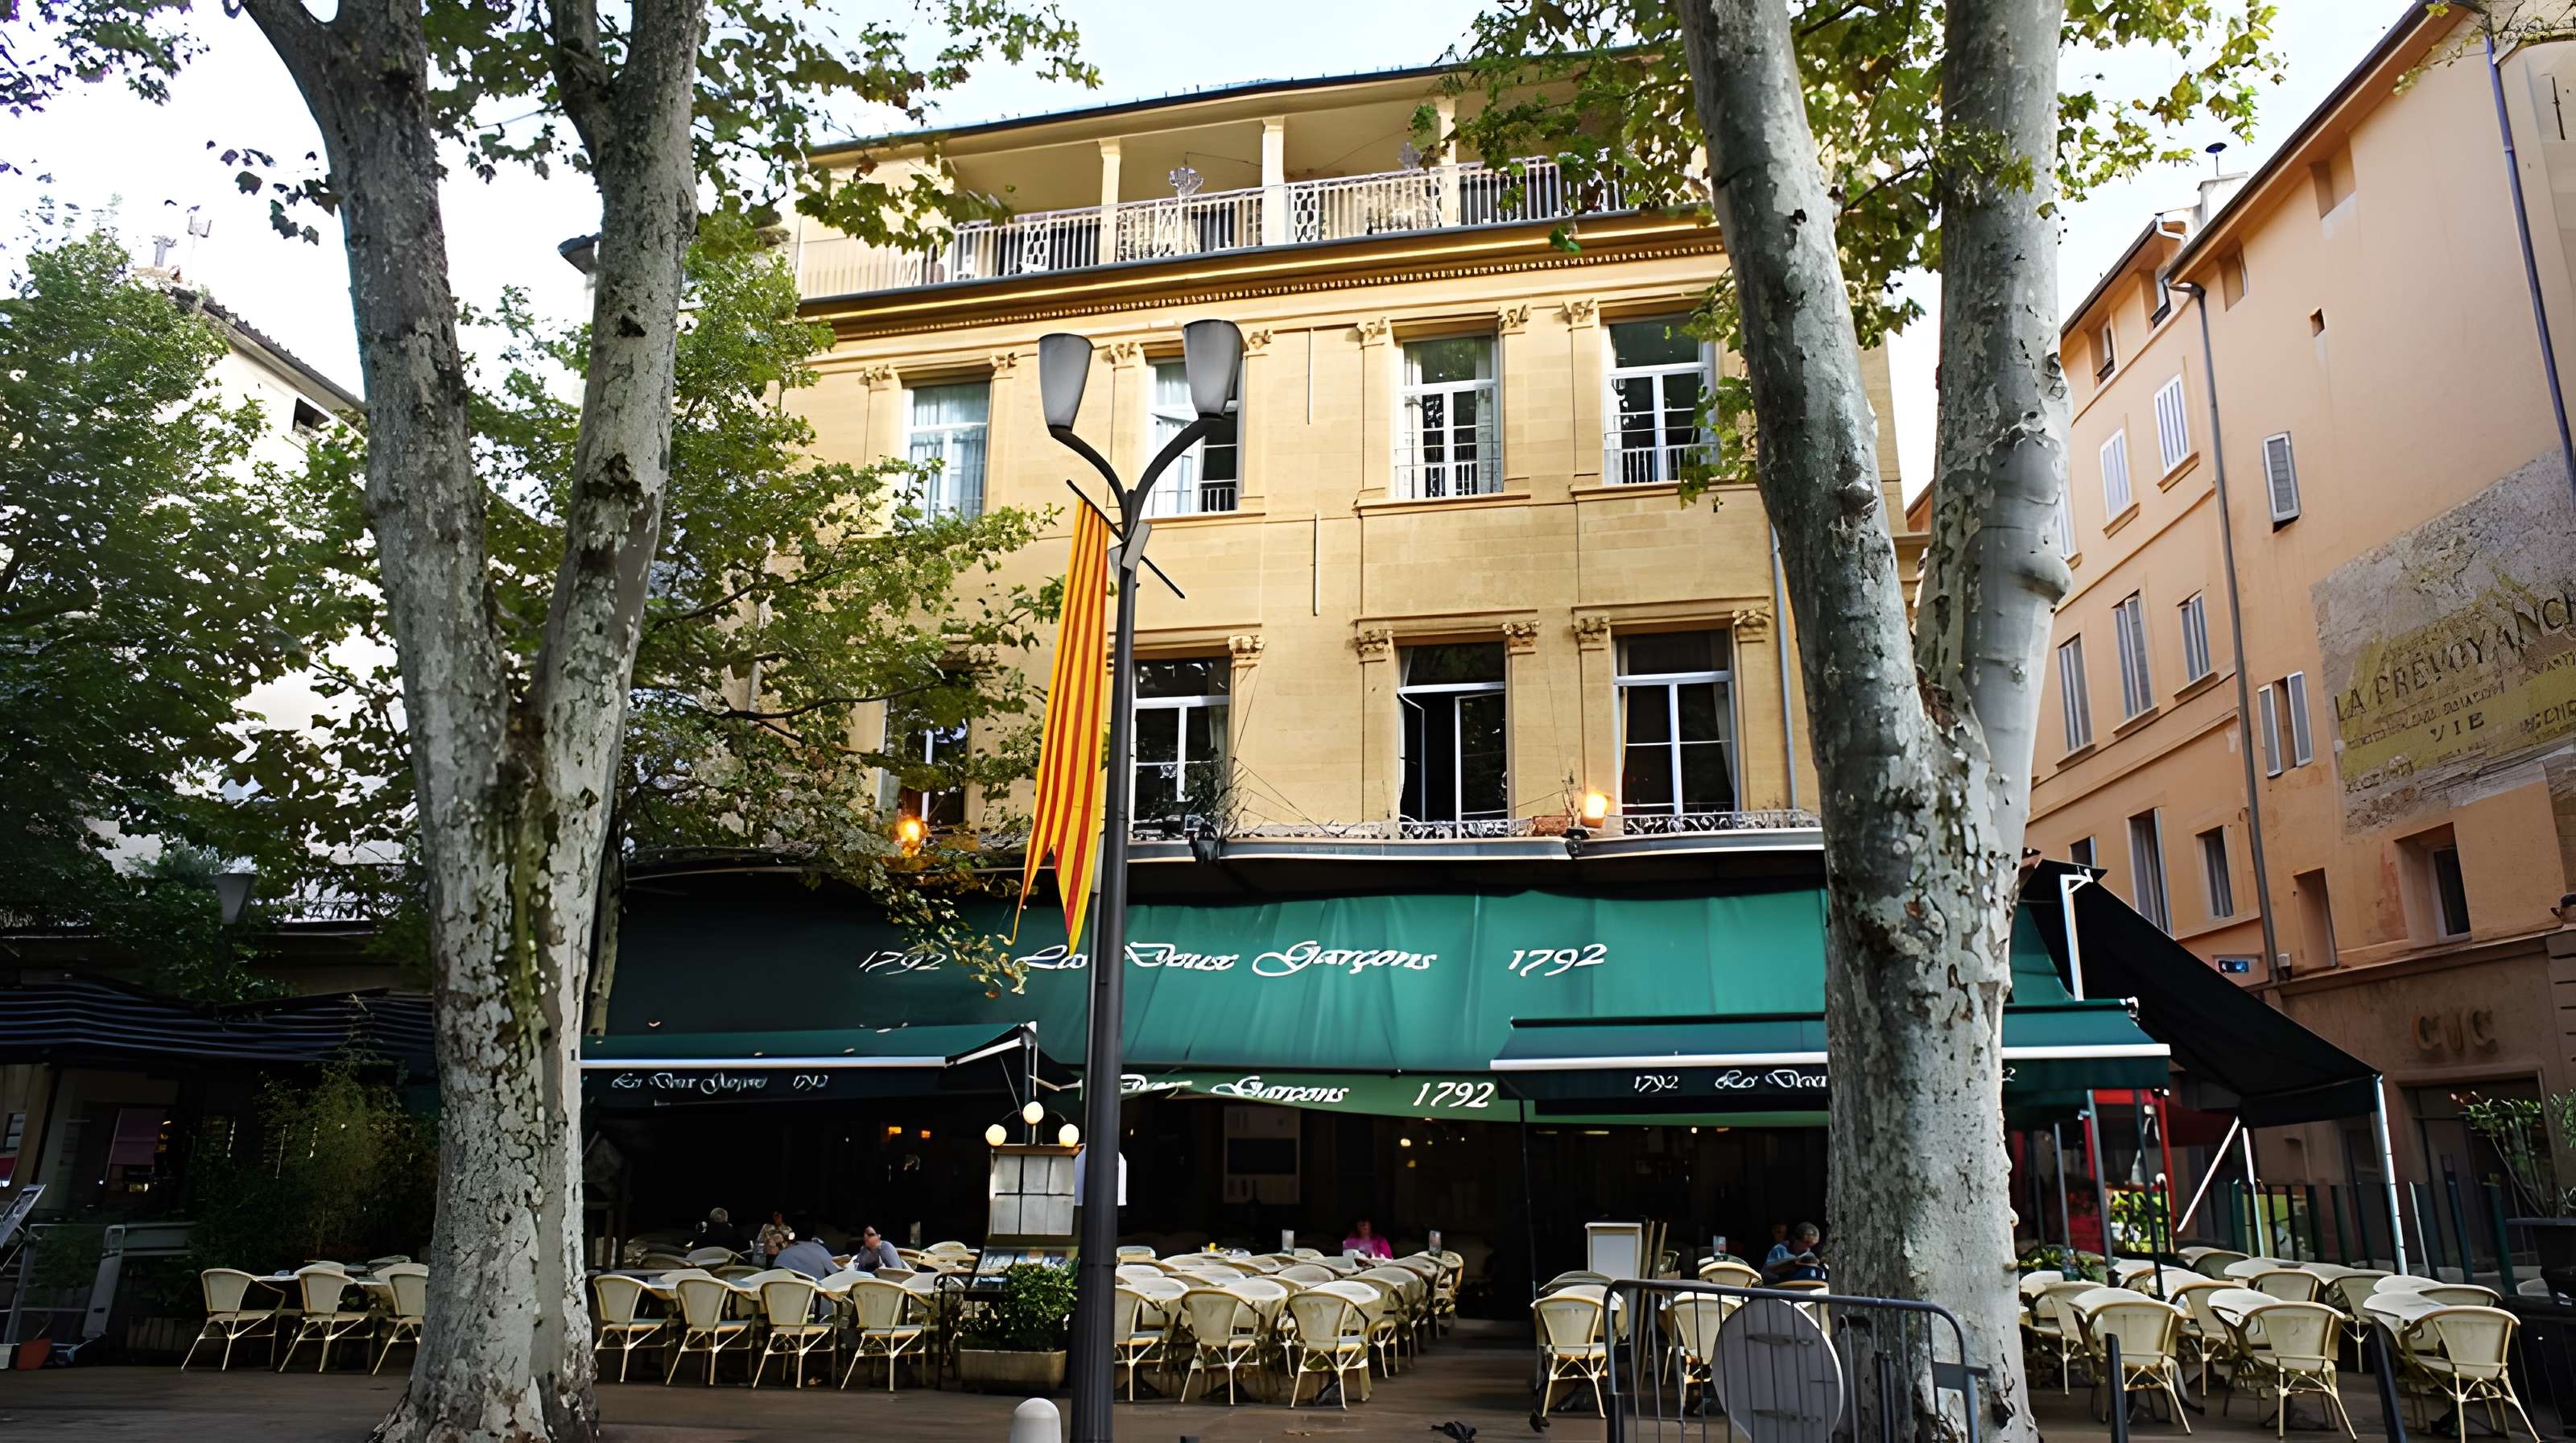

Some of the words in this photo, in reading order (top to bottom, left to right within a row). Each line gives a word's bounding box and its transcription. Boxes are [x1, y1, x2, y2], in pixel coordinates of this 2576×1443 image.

[2335, 689, 2367, 722] LA
[2430, 712, 2485, 742] VIE
[1508, 943, 1608, 977] 1792
[1413, 1081, 1496, 1109] 1792
[1634, 1075, 1678, 1092] 1792
